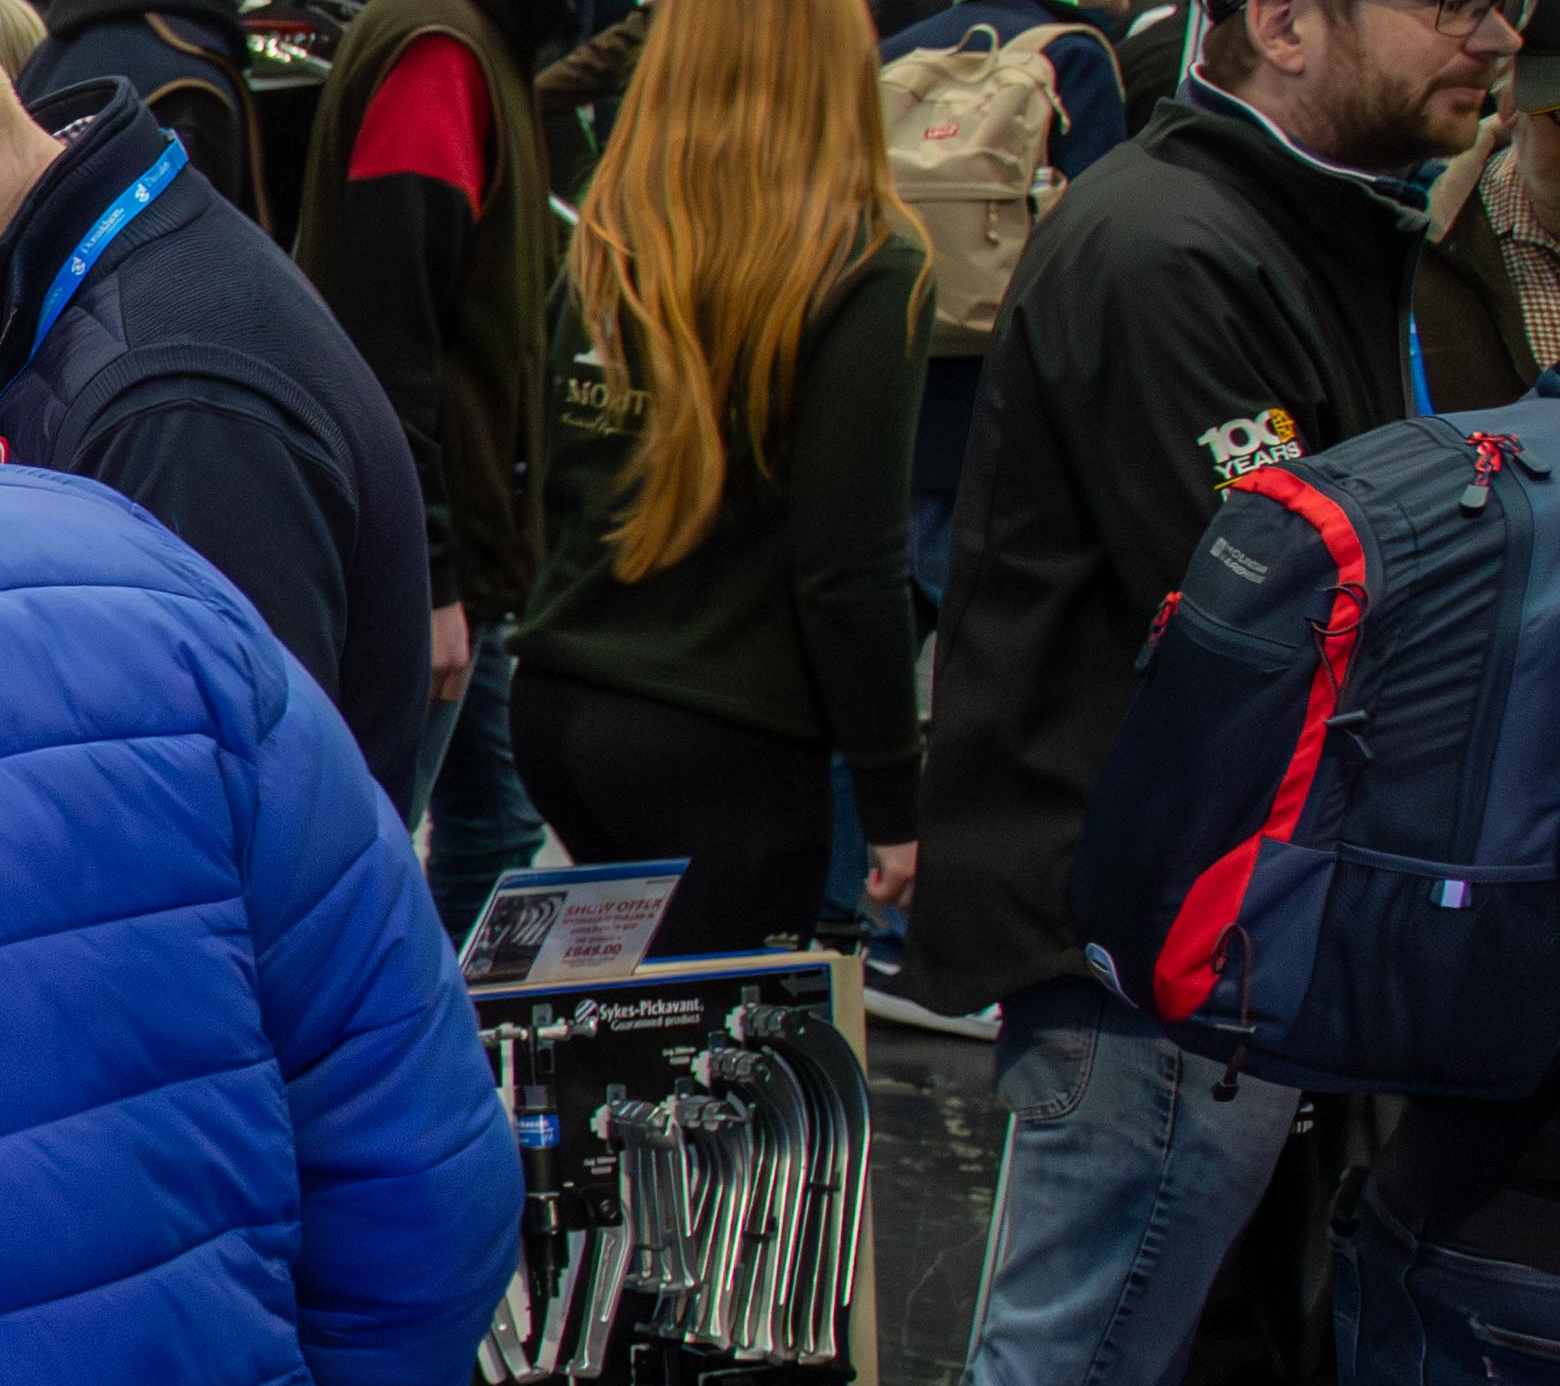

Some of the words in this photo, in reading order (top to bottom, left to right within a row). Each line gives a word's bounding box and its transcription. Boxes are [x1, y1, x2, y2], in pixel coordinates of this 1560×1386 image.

[1213, 441, 1303, 480] YEARS
[616, 898, 665, 912] OFFER
[599, 997, 700, 1023] Sykes-Pickavant
